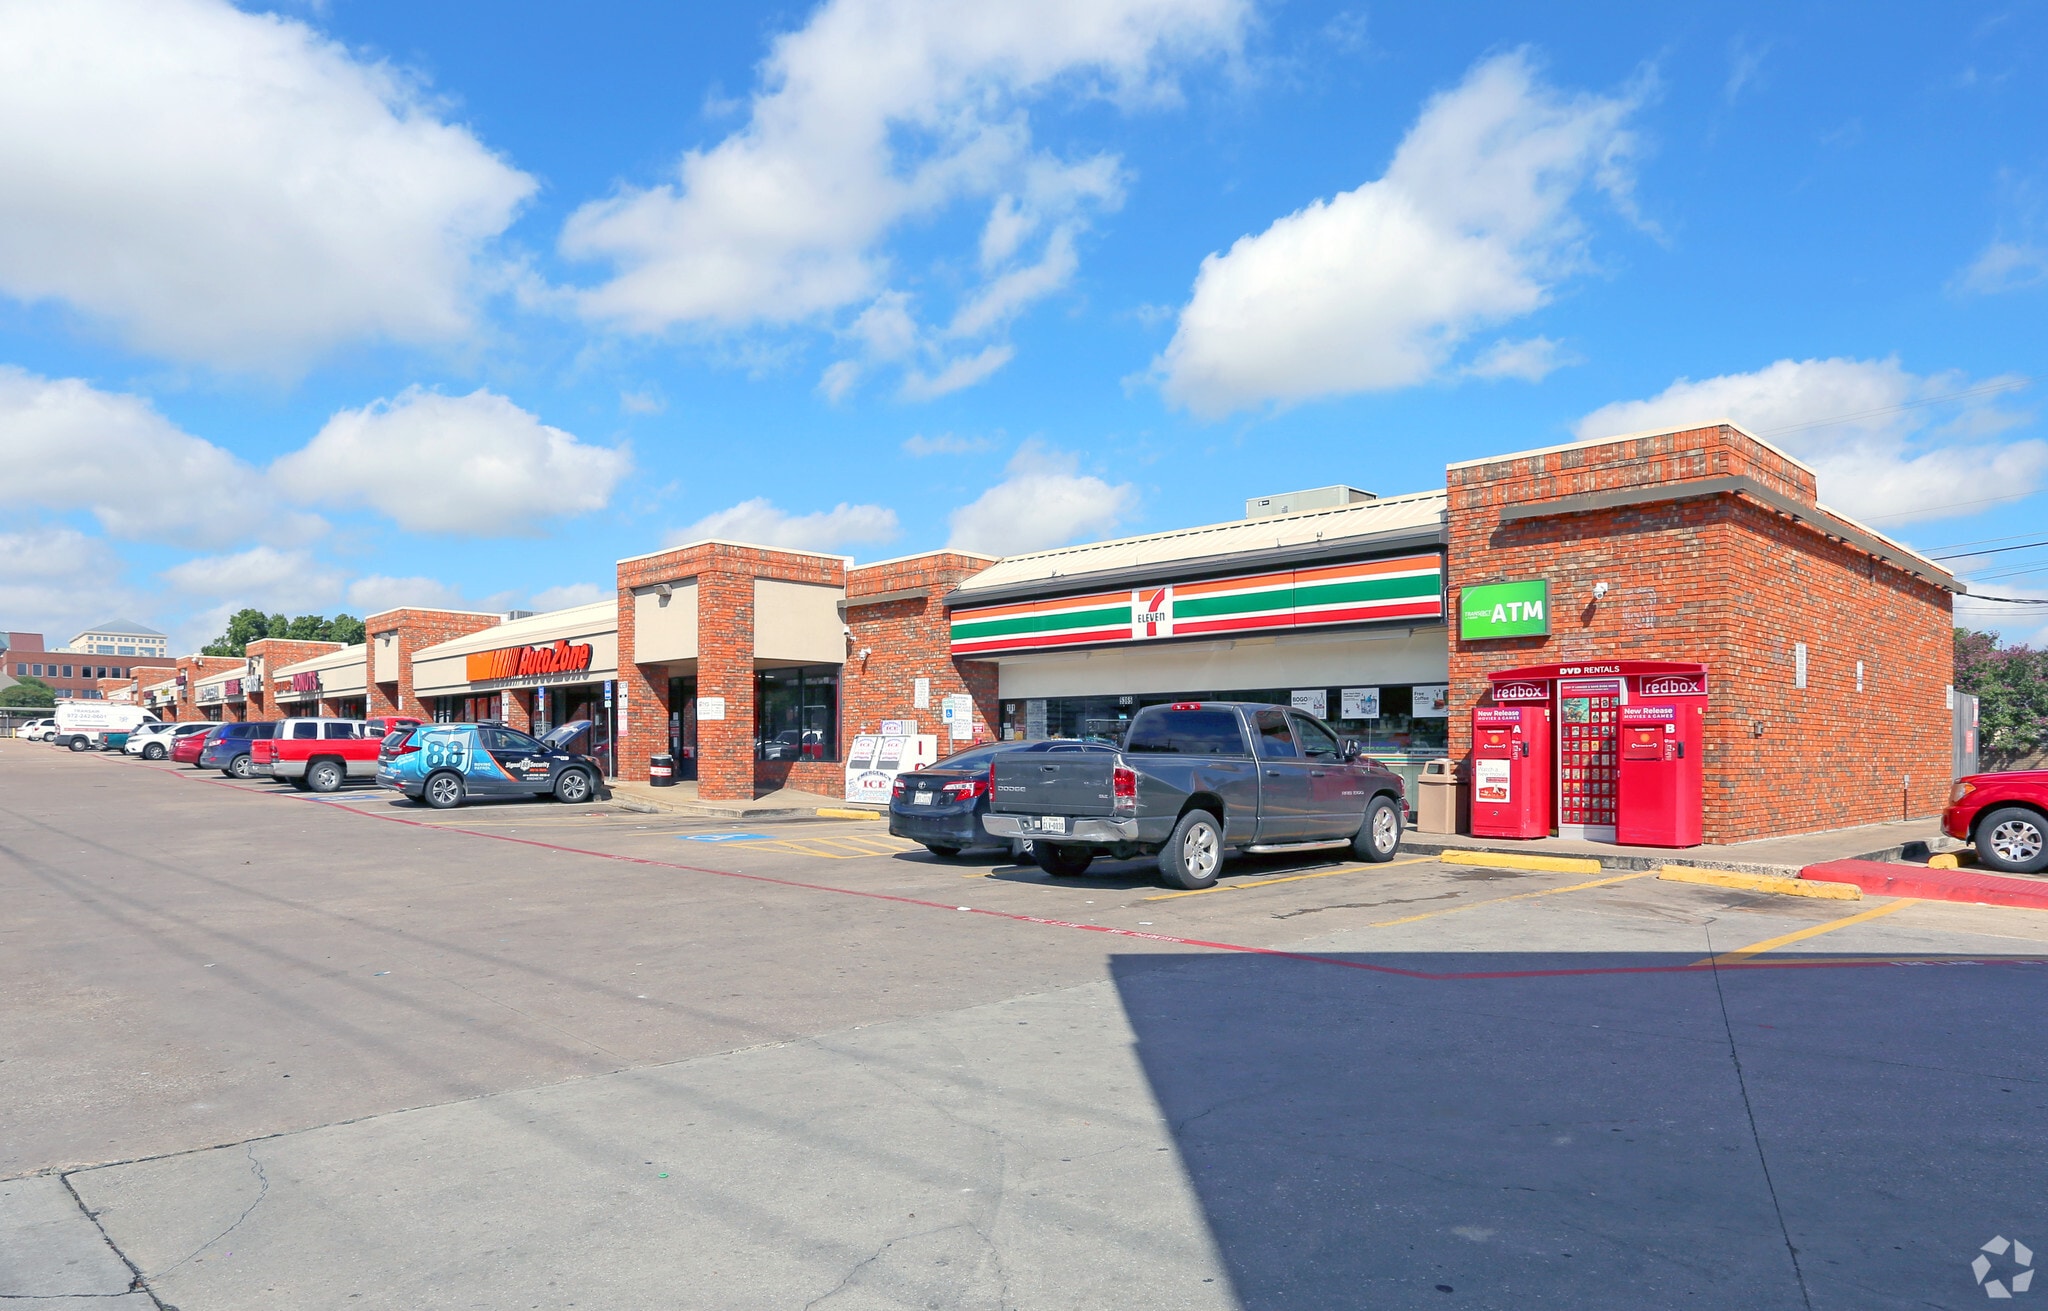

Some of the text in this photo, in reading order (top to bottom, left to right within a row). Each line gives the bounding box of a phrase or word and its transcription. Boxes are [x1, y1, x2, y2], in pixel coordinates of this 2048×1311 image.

[1147, 588, 1164, 636] 7
[1491, 600, 1543, 623] ATM
[518, 640, 590, 675] AutoZone
[1497, 686, 1542, 698] redbox
[1646, 680, 1698, 693] redbox
[1513, 725, 1521, 733] A
[1666, 724, 1675, 733] B
[426, 741, 463, 768] 88
[863, 780, 886, 788] ICE
